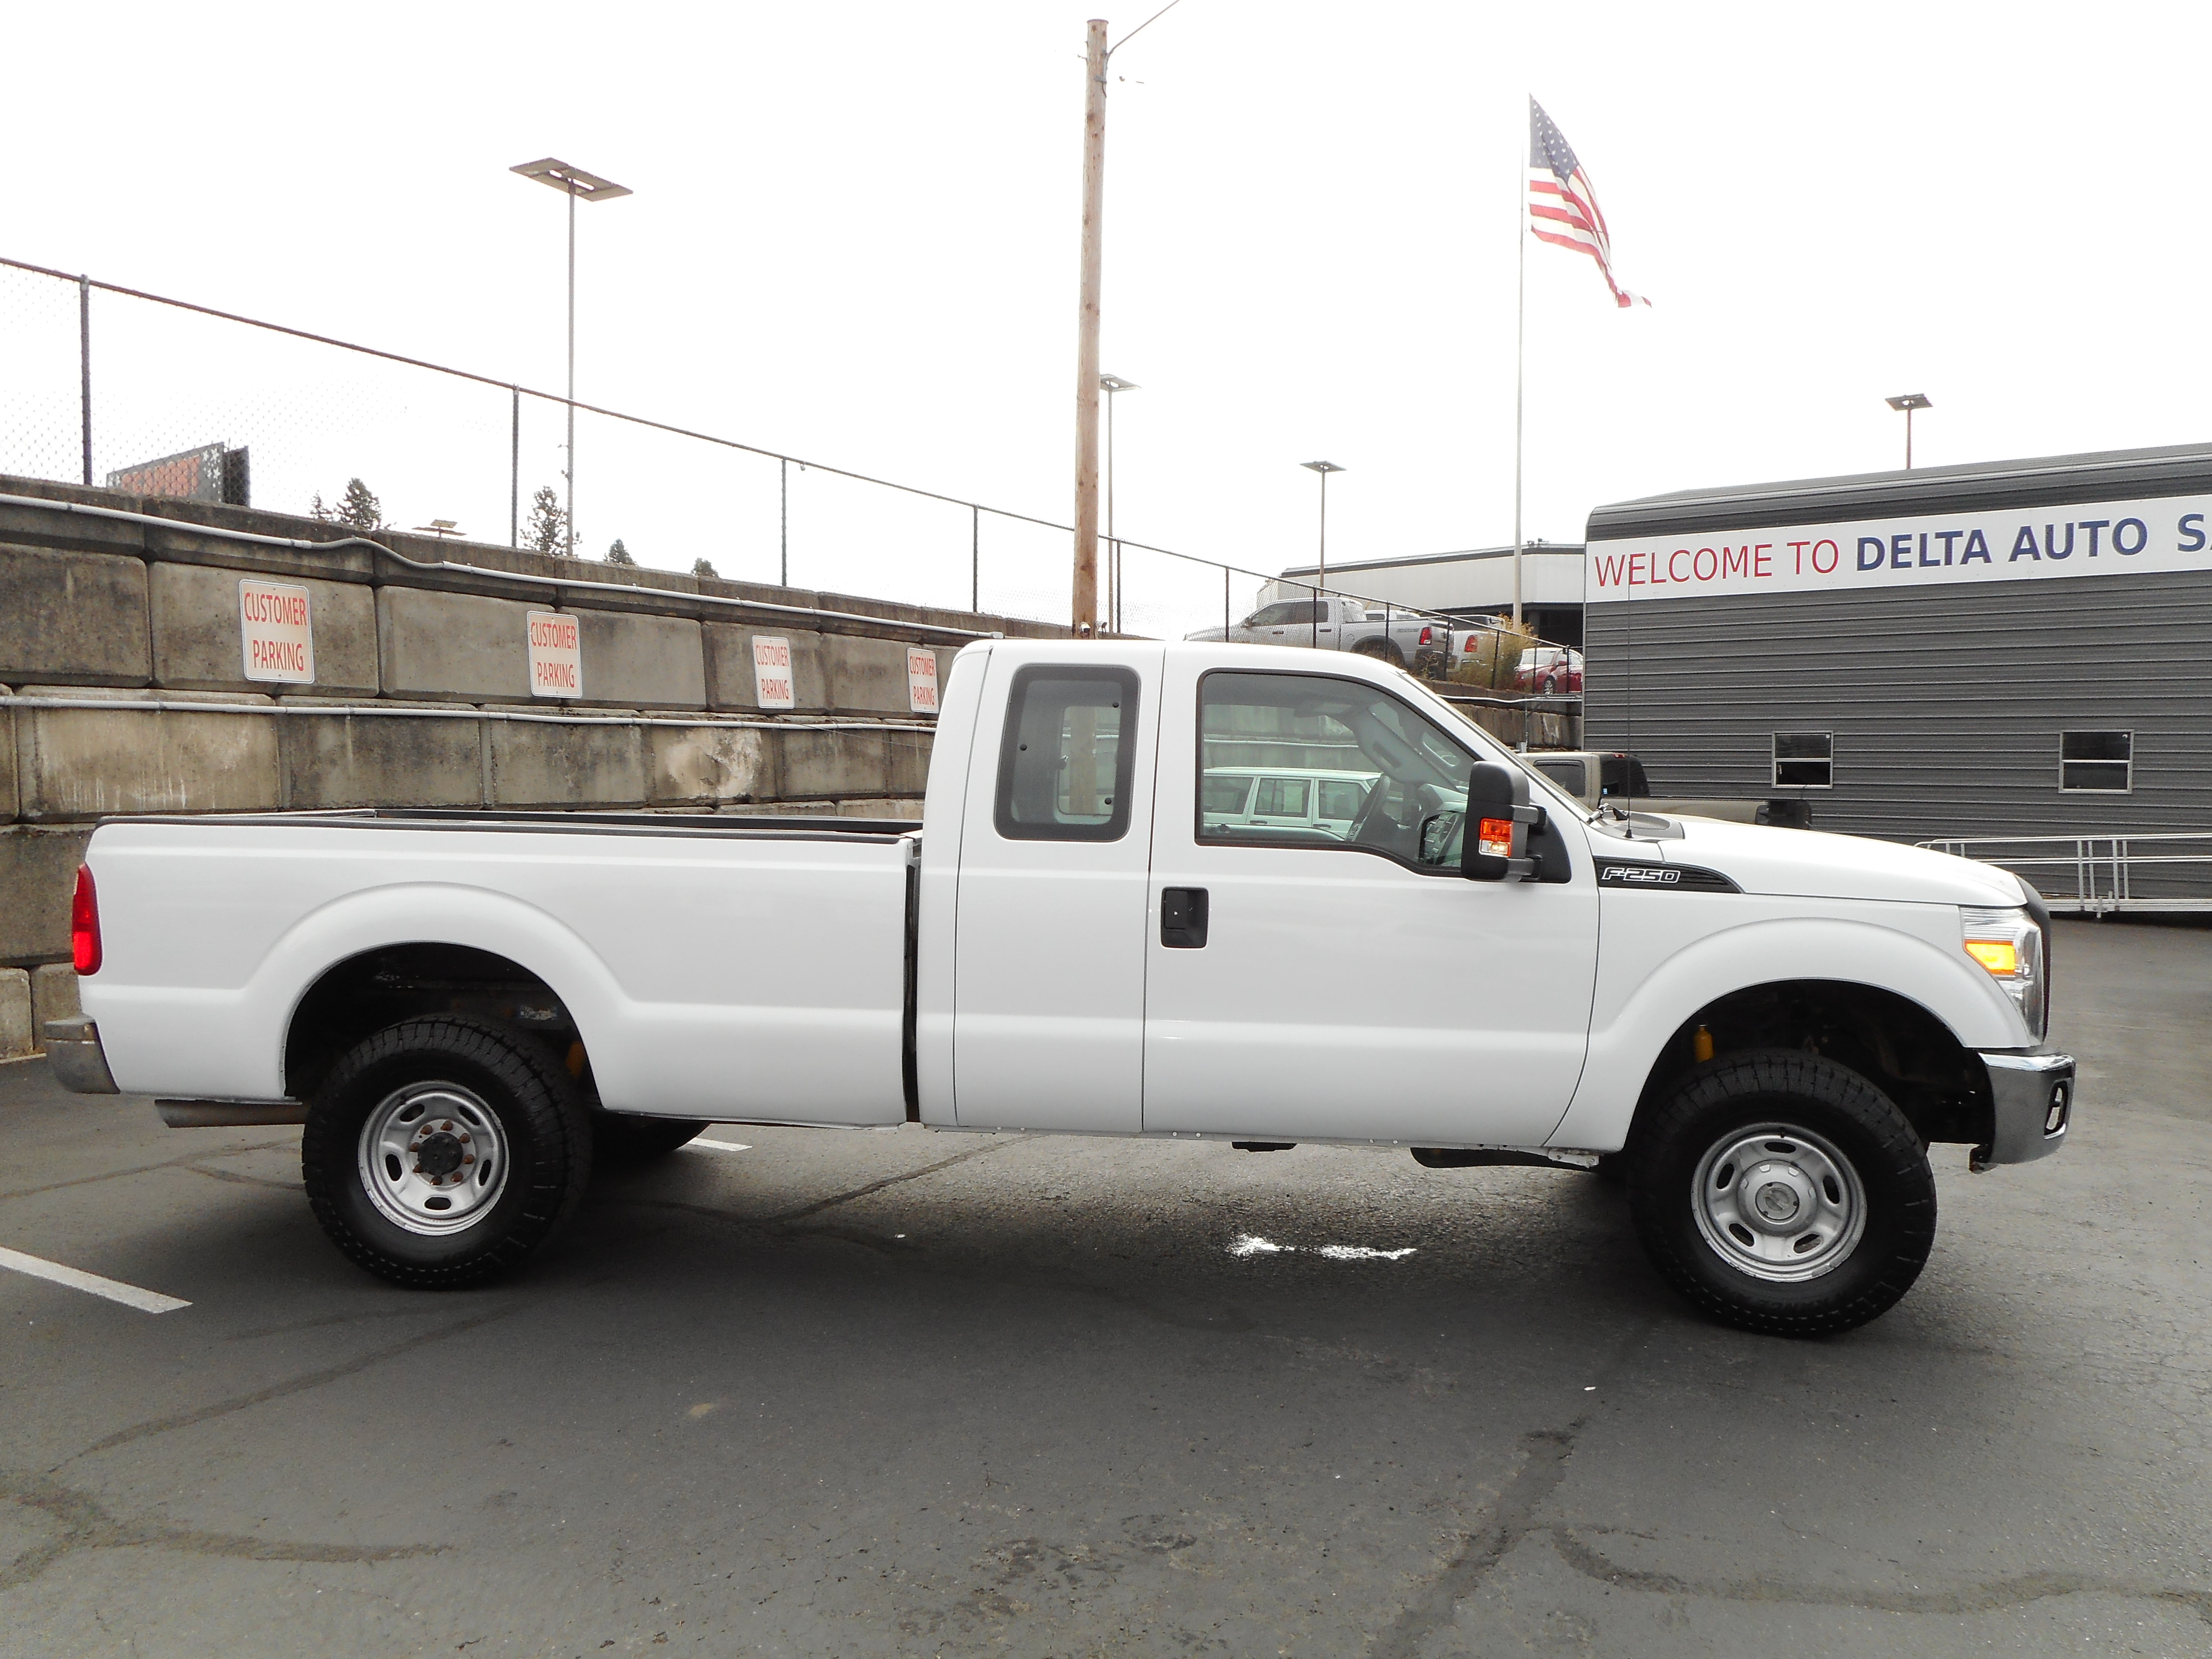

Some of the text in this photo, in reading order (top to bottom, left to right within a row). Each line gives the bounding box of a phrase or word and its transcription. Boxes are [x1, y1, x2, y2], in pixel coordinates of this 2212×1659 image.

[1595, 514, 2212, 587] WELCOME TO DELTA AUTO S
[244, 592, 307, 626] CUSTOMER
[530, 621, 577, 650] CUSTOMER
[252, 639, 304, 672] PARKING
[755, 644, 789, 667] CUSTOMER
[909, 656, 935, 676] CUSTOMER
[537, 662, 575, 688] PARKING
[762, 678, 789, 700] PARKING
[913, 687, 935, 705] PARKING
[1601, 866, 1681, 884] F-250
